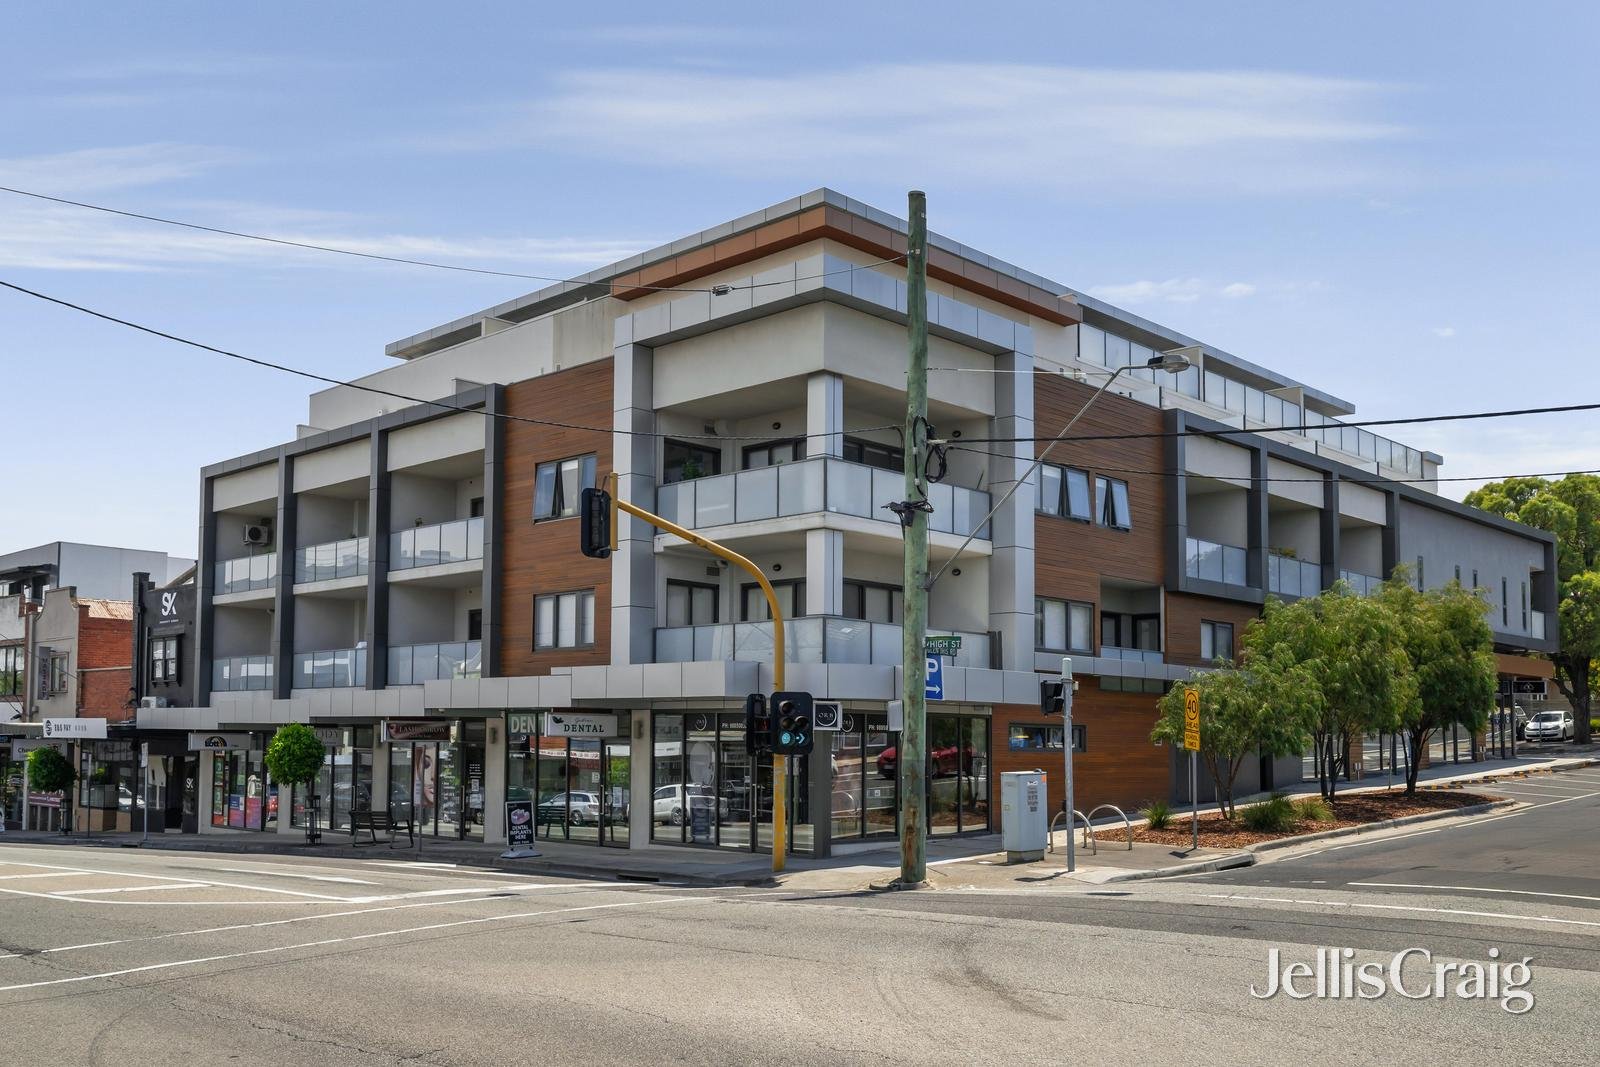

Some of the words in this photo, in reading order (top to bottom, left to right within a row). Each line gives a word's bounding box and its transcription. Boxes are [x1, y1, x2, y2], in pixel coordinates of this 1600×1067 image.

[930, 640, 949, 648] HIGH
[951, 640, 961, 648] ST
[926, 659, 939, 681] P
[1187, 699, 1197, 714] 40
[563, 724, 605, 733] DENTAL
